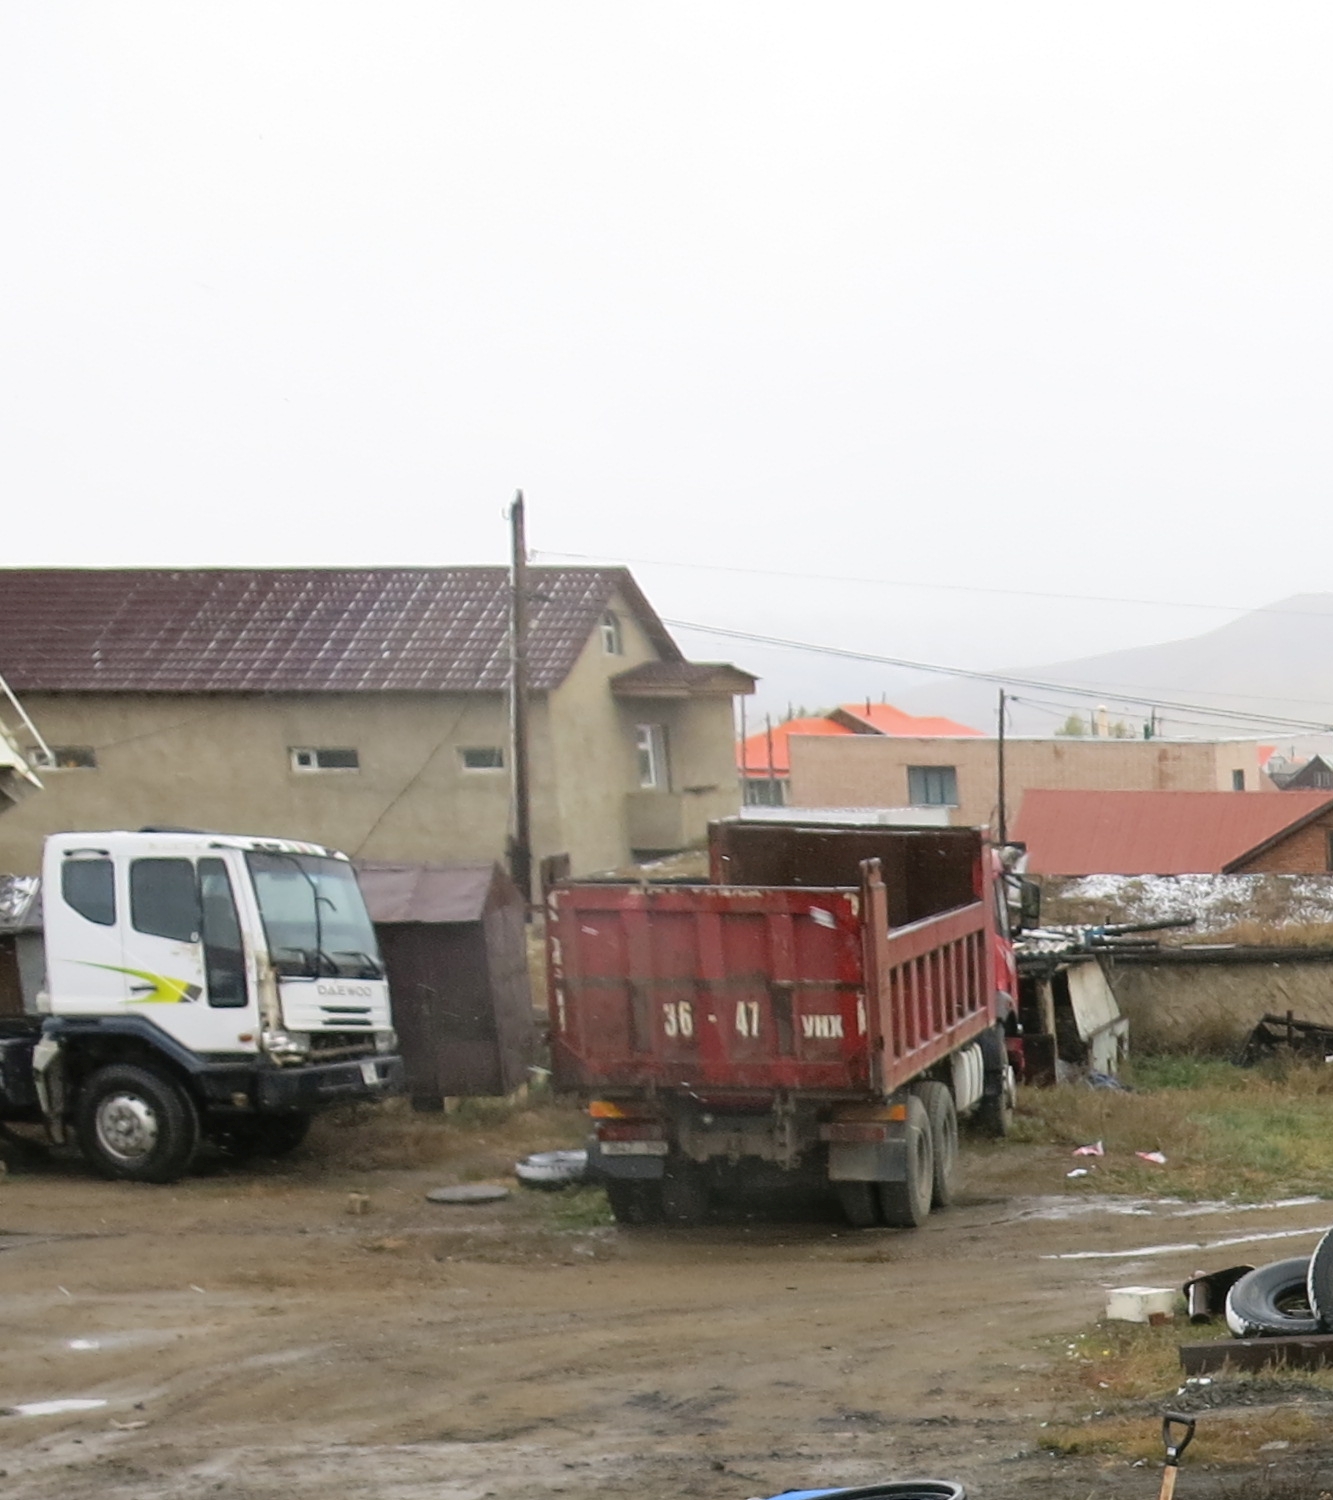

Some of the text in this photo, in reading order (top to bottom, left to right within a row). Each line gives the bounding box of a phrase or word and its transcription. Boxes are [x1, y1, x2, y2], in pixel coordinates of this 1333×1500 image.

[317, 984, 371, 997] DAEWOO
[663, 1000, 693, 1037] 36
[735, 1001, 760, 1037] 47
[801, 1015, 844, 1037] УНХ
